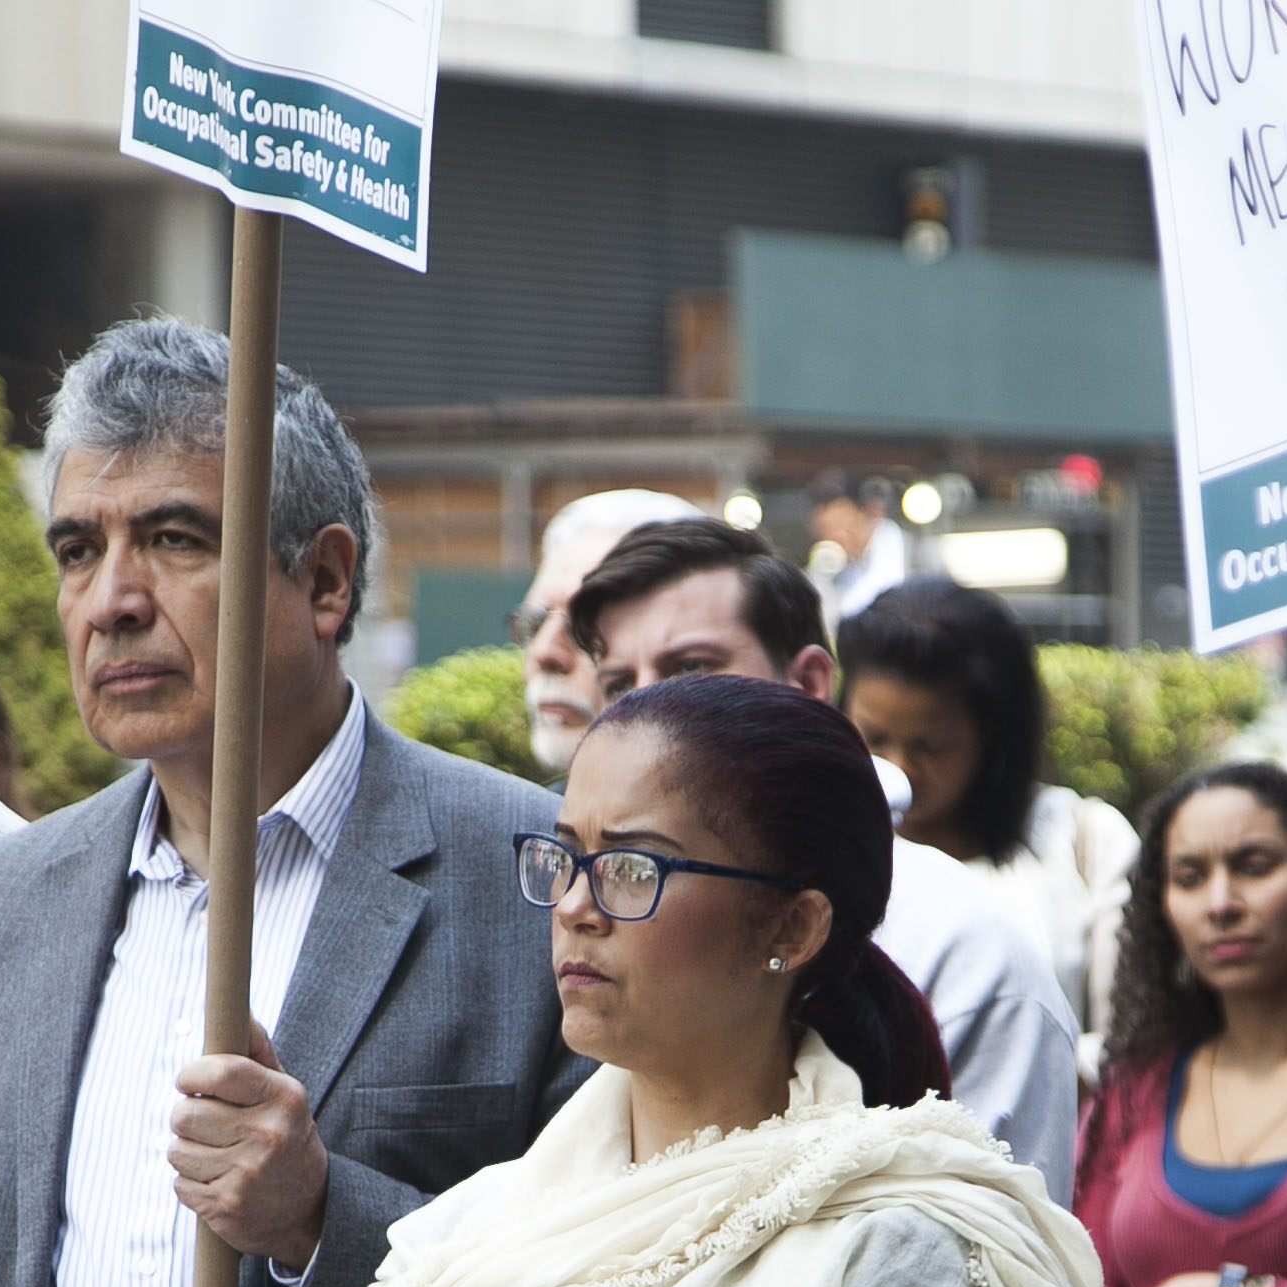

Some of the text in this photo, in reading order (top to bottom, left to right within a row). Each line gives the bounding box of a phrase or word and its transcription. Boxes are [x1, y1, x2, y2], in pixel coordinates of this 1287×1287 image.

[169, 51, 391, 167] New York Committee for
[254, 135, 335, 194] Safety
[335, 159, 348, 193] &
[350, 165, 411, 222] Health
